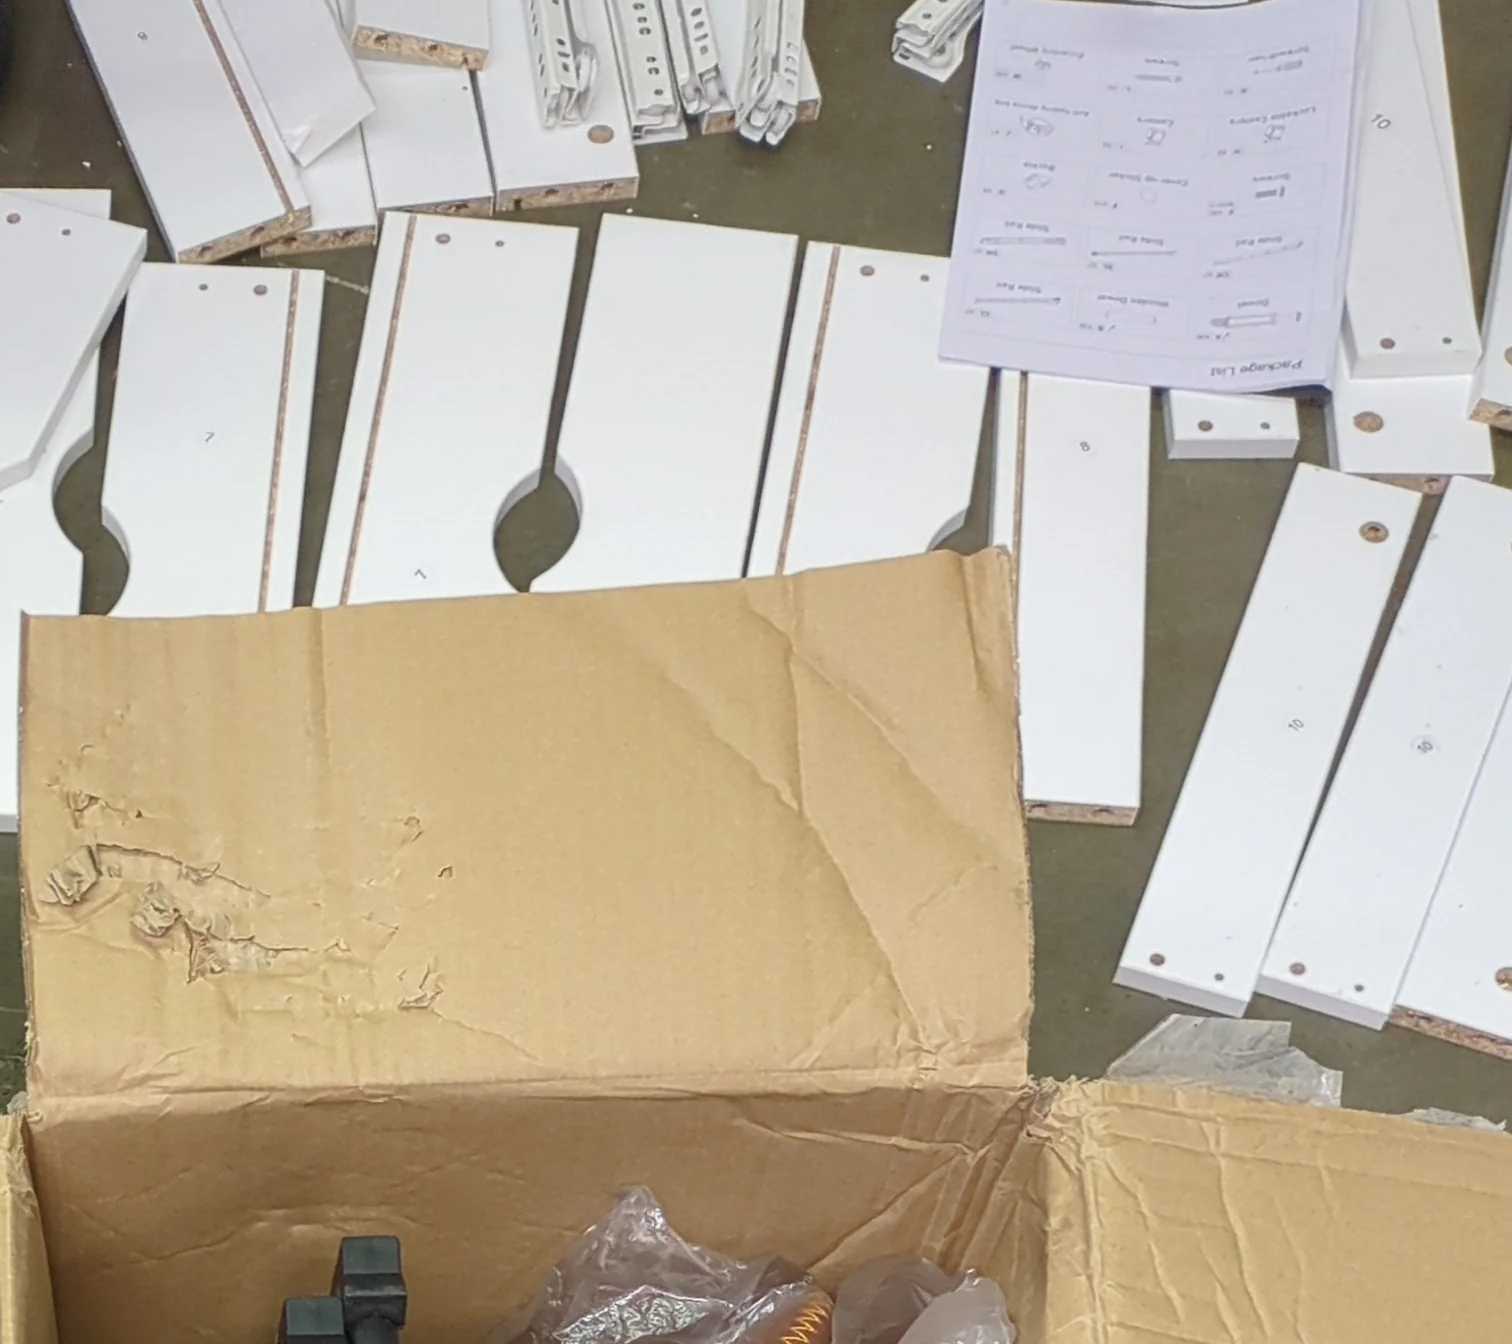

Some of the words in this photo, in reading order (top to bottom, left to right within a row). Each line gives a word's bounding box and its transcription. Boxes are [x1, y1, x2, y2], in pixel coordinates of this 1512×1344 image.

[1370, 114, 1391, 129] 10
[1210, 366, 1235, 377] List
[1240, 358, 1303, 374] Package
[1288, 719, 1304, 732] 10
